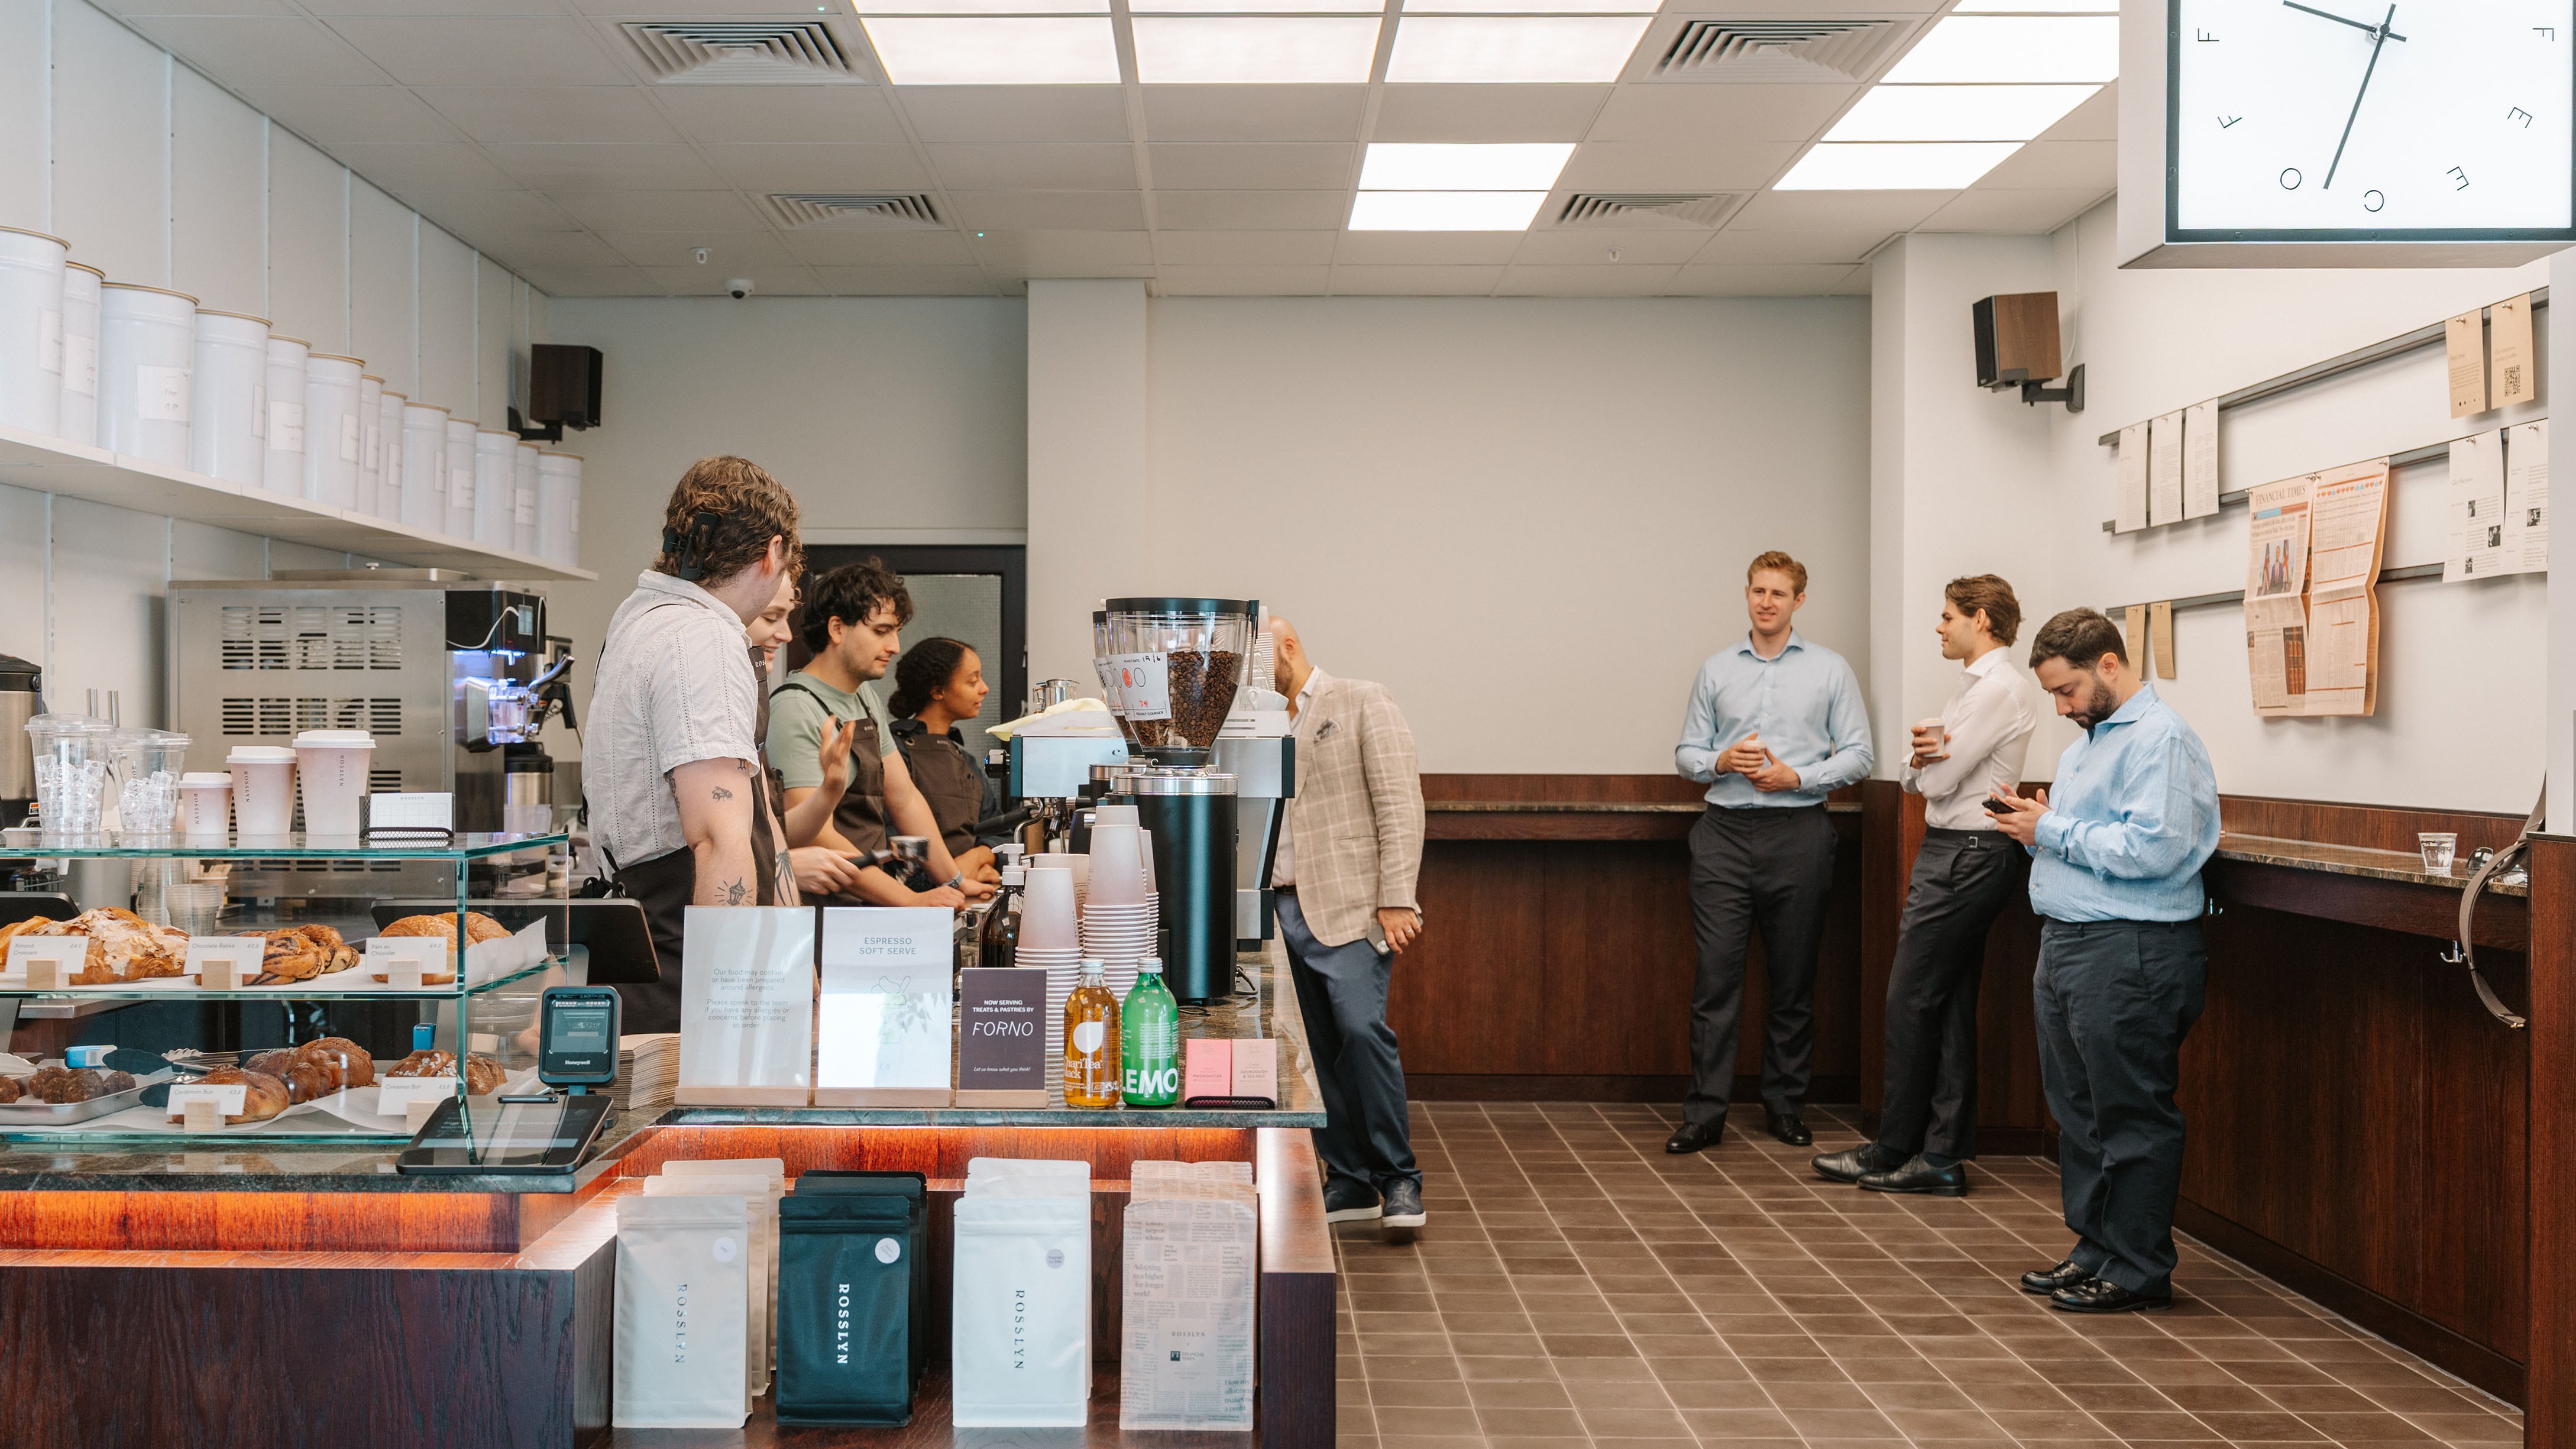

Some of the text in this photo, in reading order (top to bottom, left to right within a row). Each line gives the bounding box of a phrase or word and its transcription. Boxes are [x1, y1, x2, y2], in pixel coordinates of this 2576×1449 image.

[2256, 485, 2305, 505] FINANCIAL TIMES
[972, 1021, 1034, 1037] FORNO
[1064, 1067, 1082, 1079] lack
[675, 1284, 687, 1363] ROSSLYN
[837, 1283, 850, 1364] ROSSLYN
[1015, 1290, 1025, 1369] ROSSLYN
